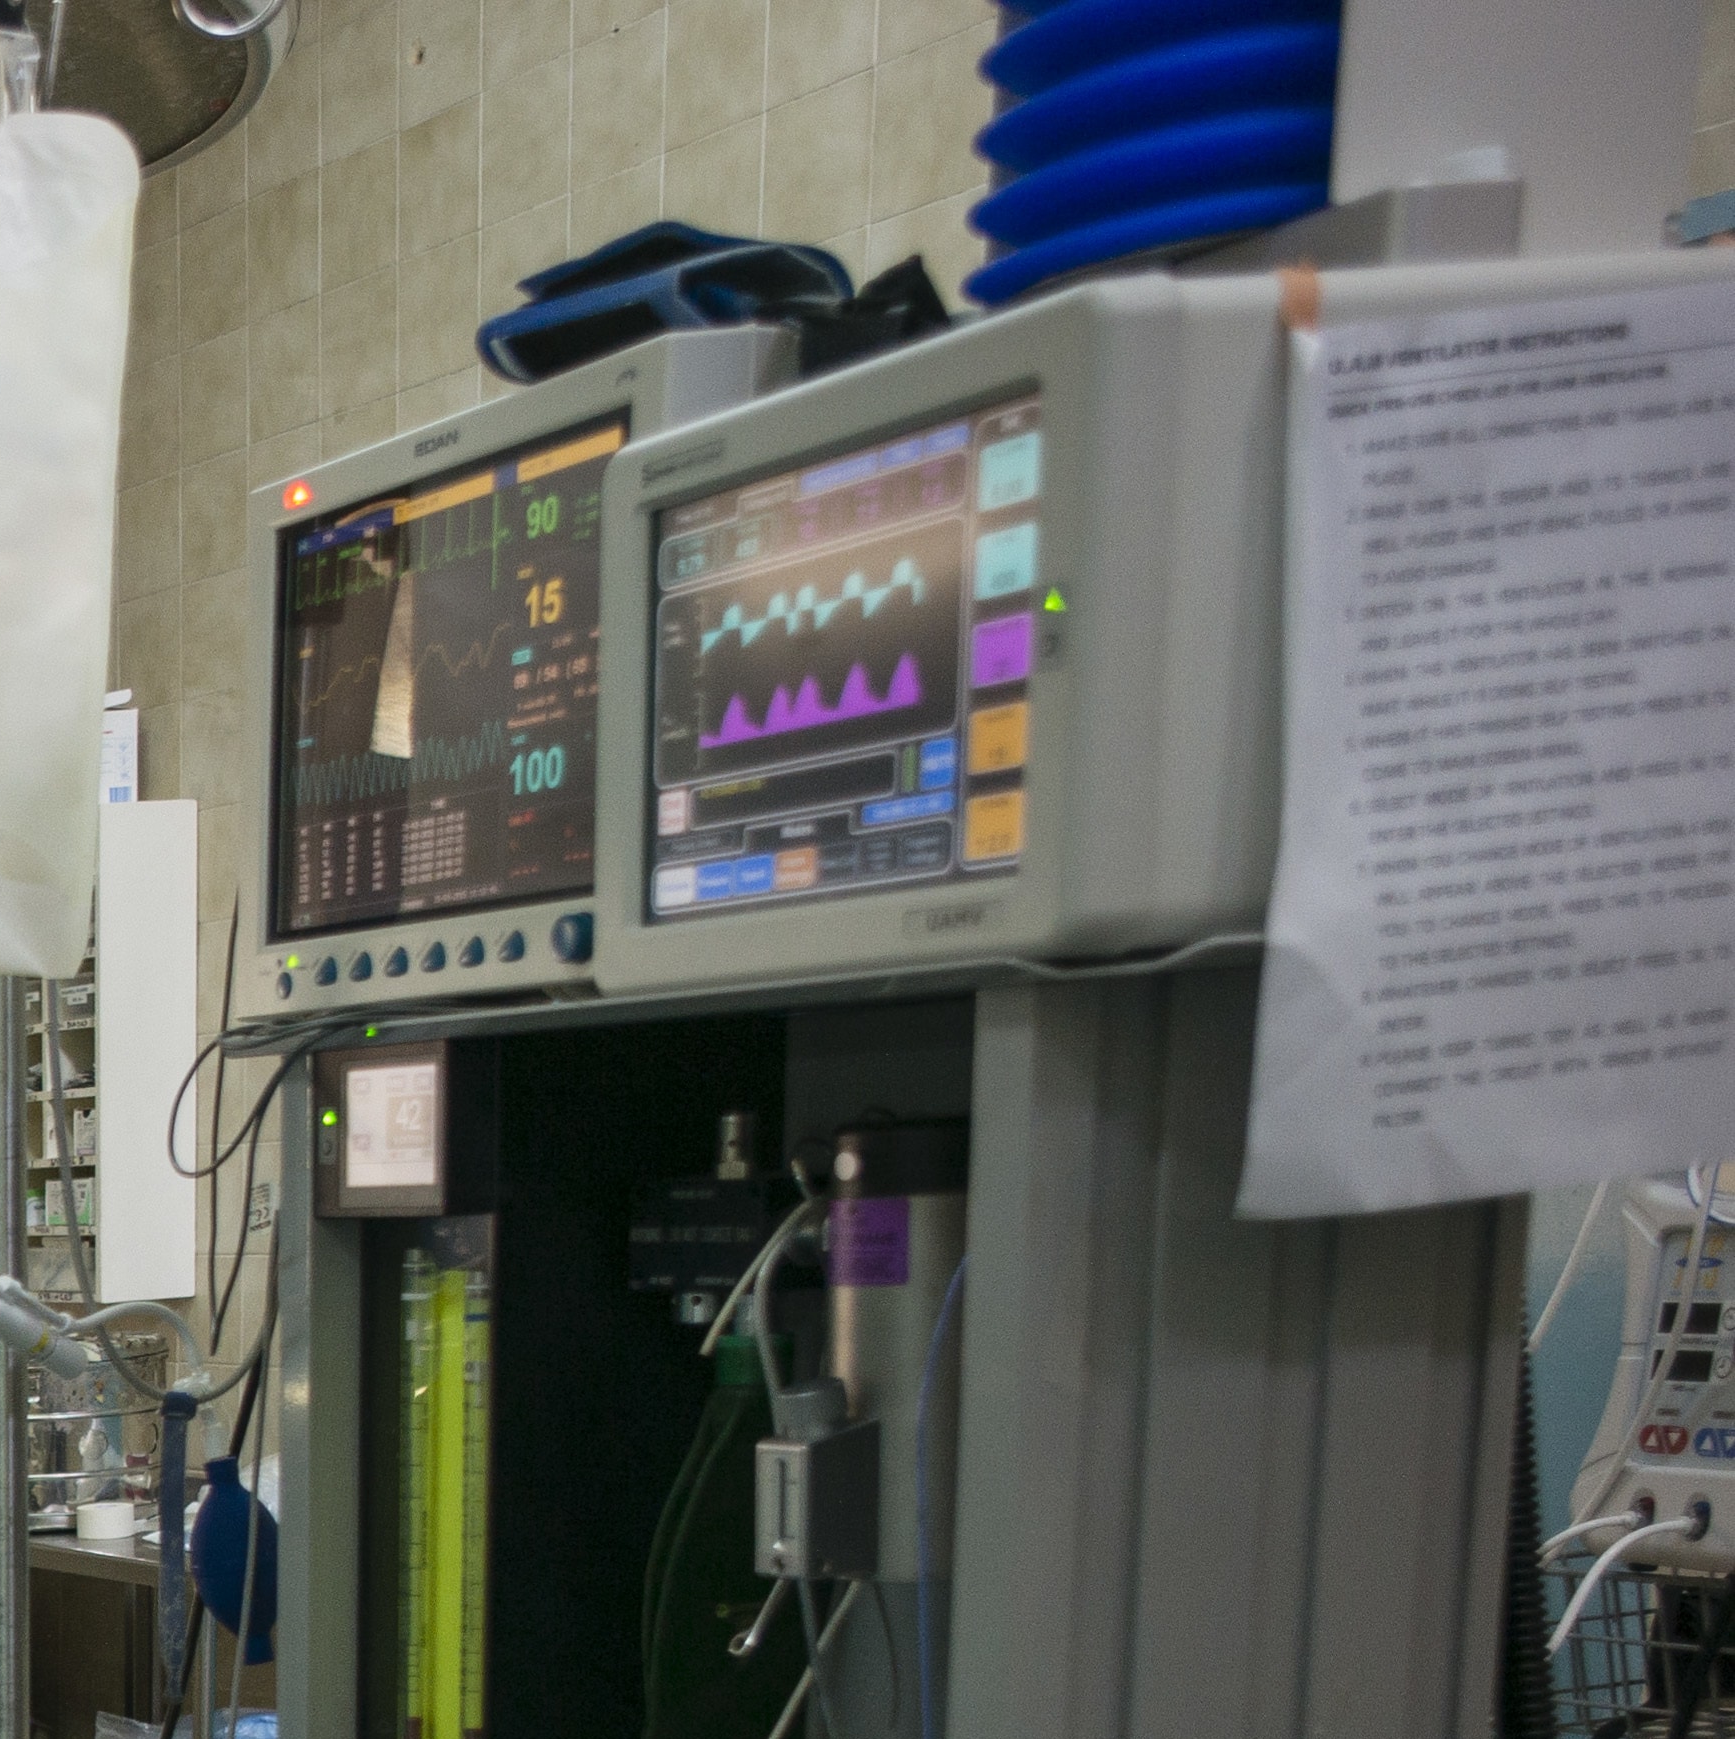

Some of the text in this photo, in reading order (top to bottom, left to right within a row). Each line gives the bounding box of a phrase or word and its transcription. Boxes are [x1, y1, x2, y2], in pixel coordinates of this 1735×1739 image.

[527, 494, 559, 540] 90
[526, 577, 564, 628] 15
[510, 745, 566, 795] 100
